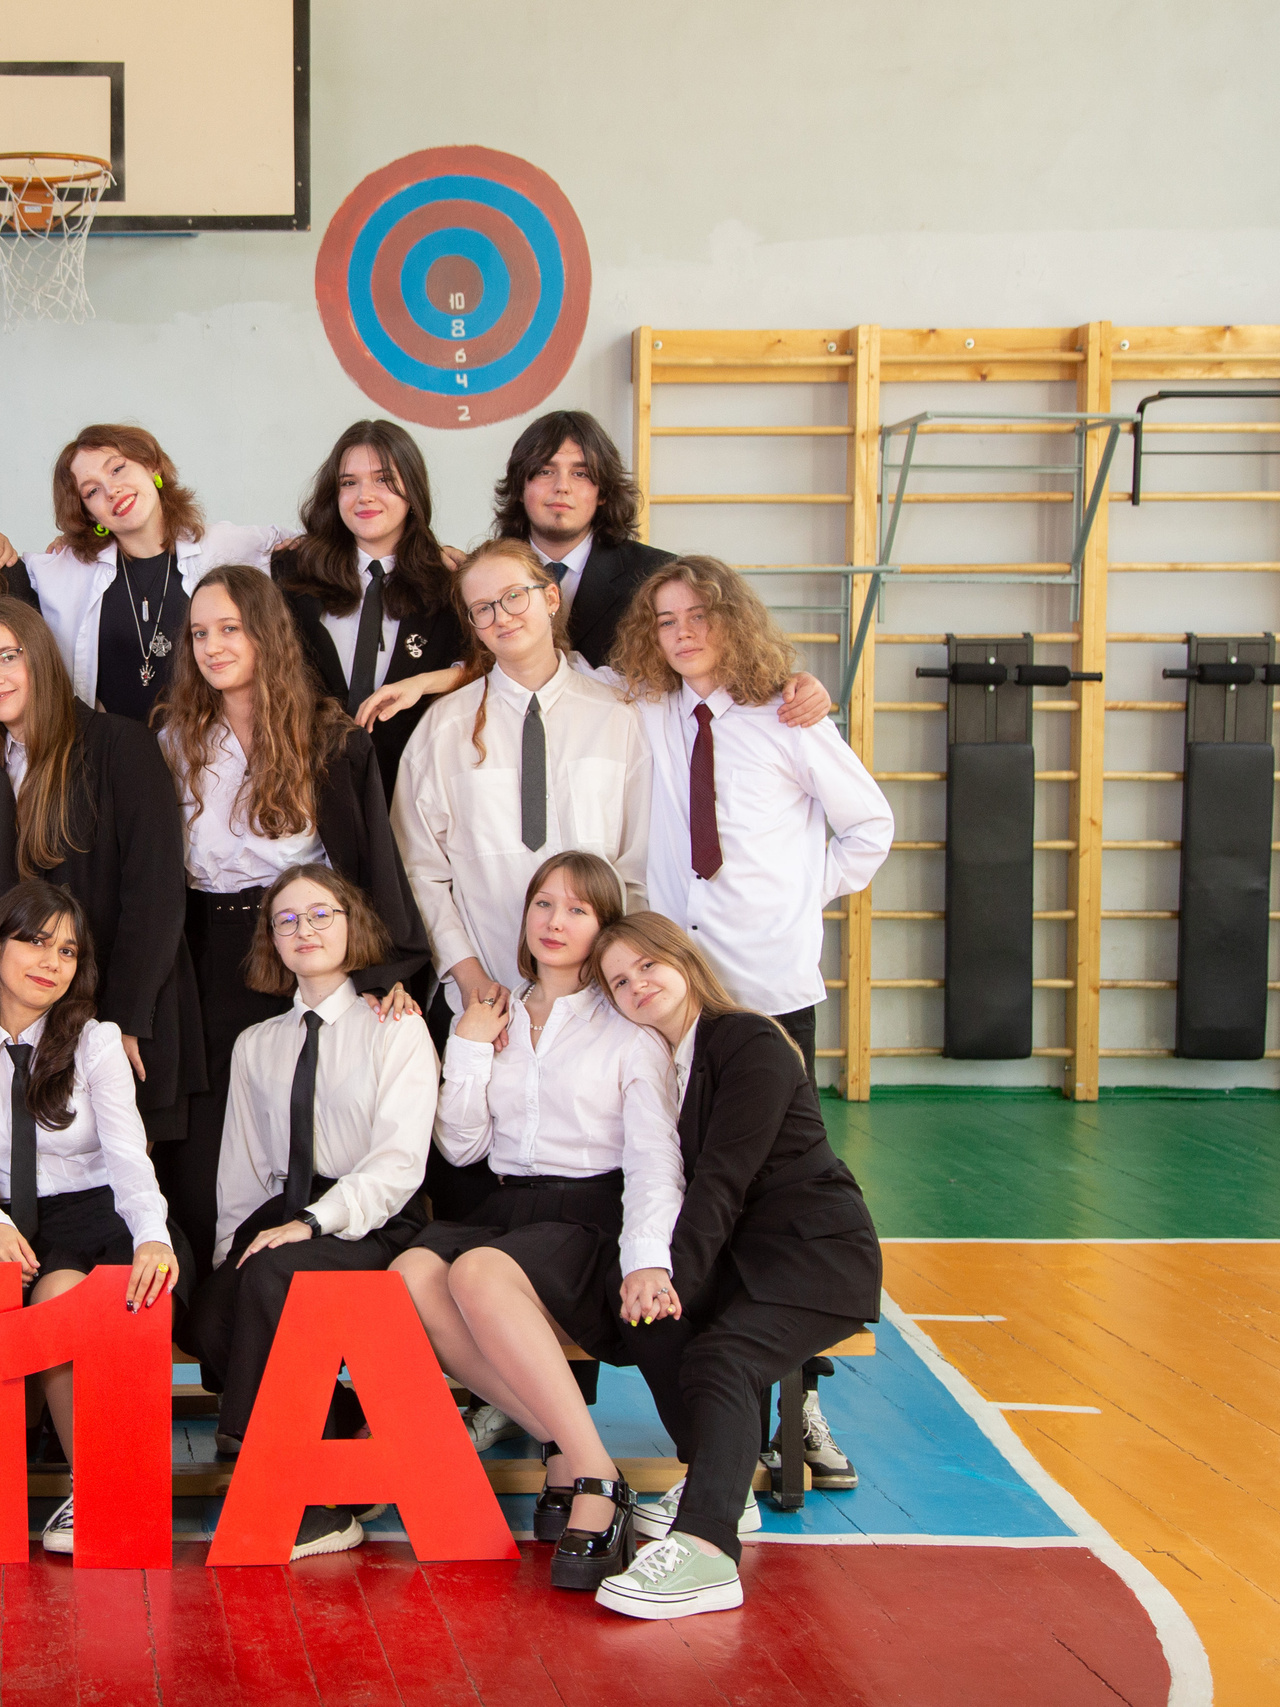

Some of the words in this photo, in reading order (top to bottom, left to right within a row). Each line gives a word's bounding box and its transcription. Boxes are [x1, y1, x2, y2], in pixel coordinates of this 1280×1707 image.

[449, 292, 465, 310] 10
[451, 319, 466, 337] 8
[455, 348, 467, 363] 6
[455, 373, 468, 388] 4
[457, 405, 471, 422] 2
